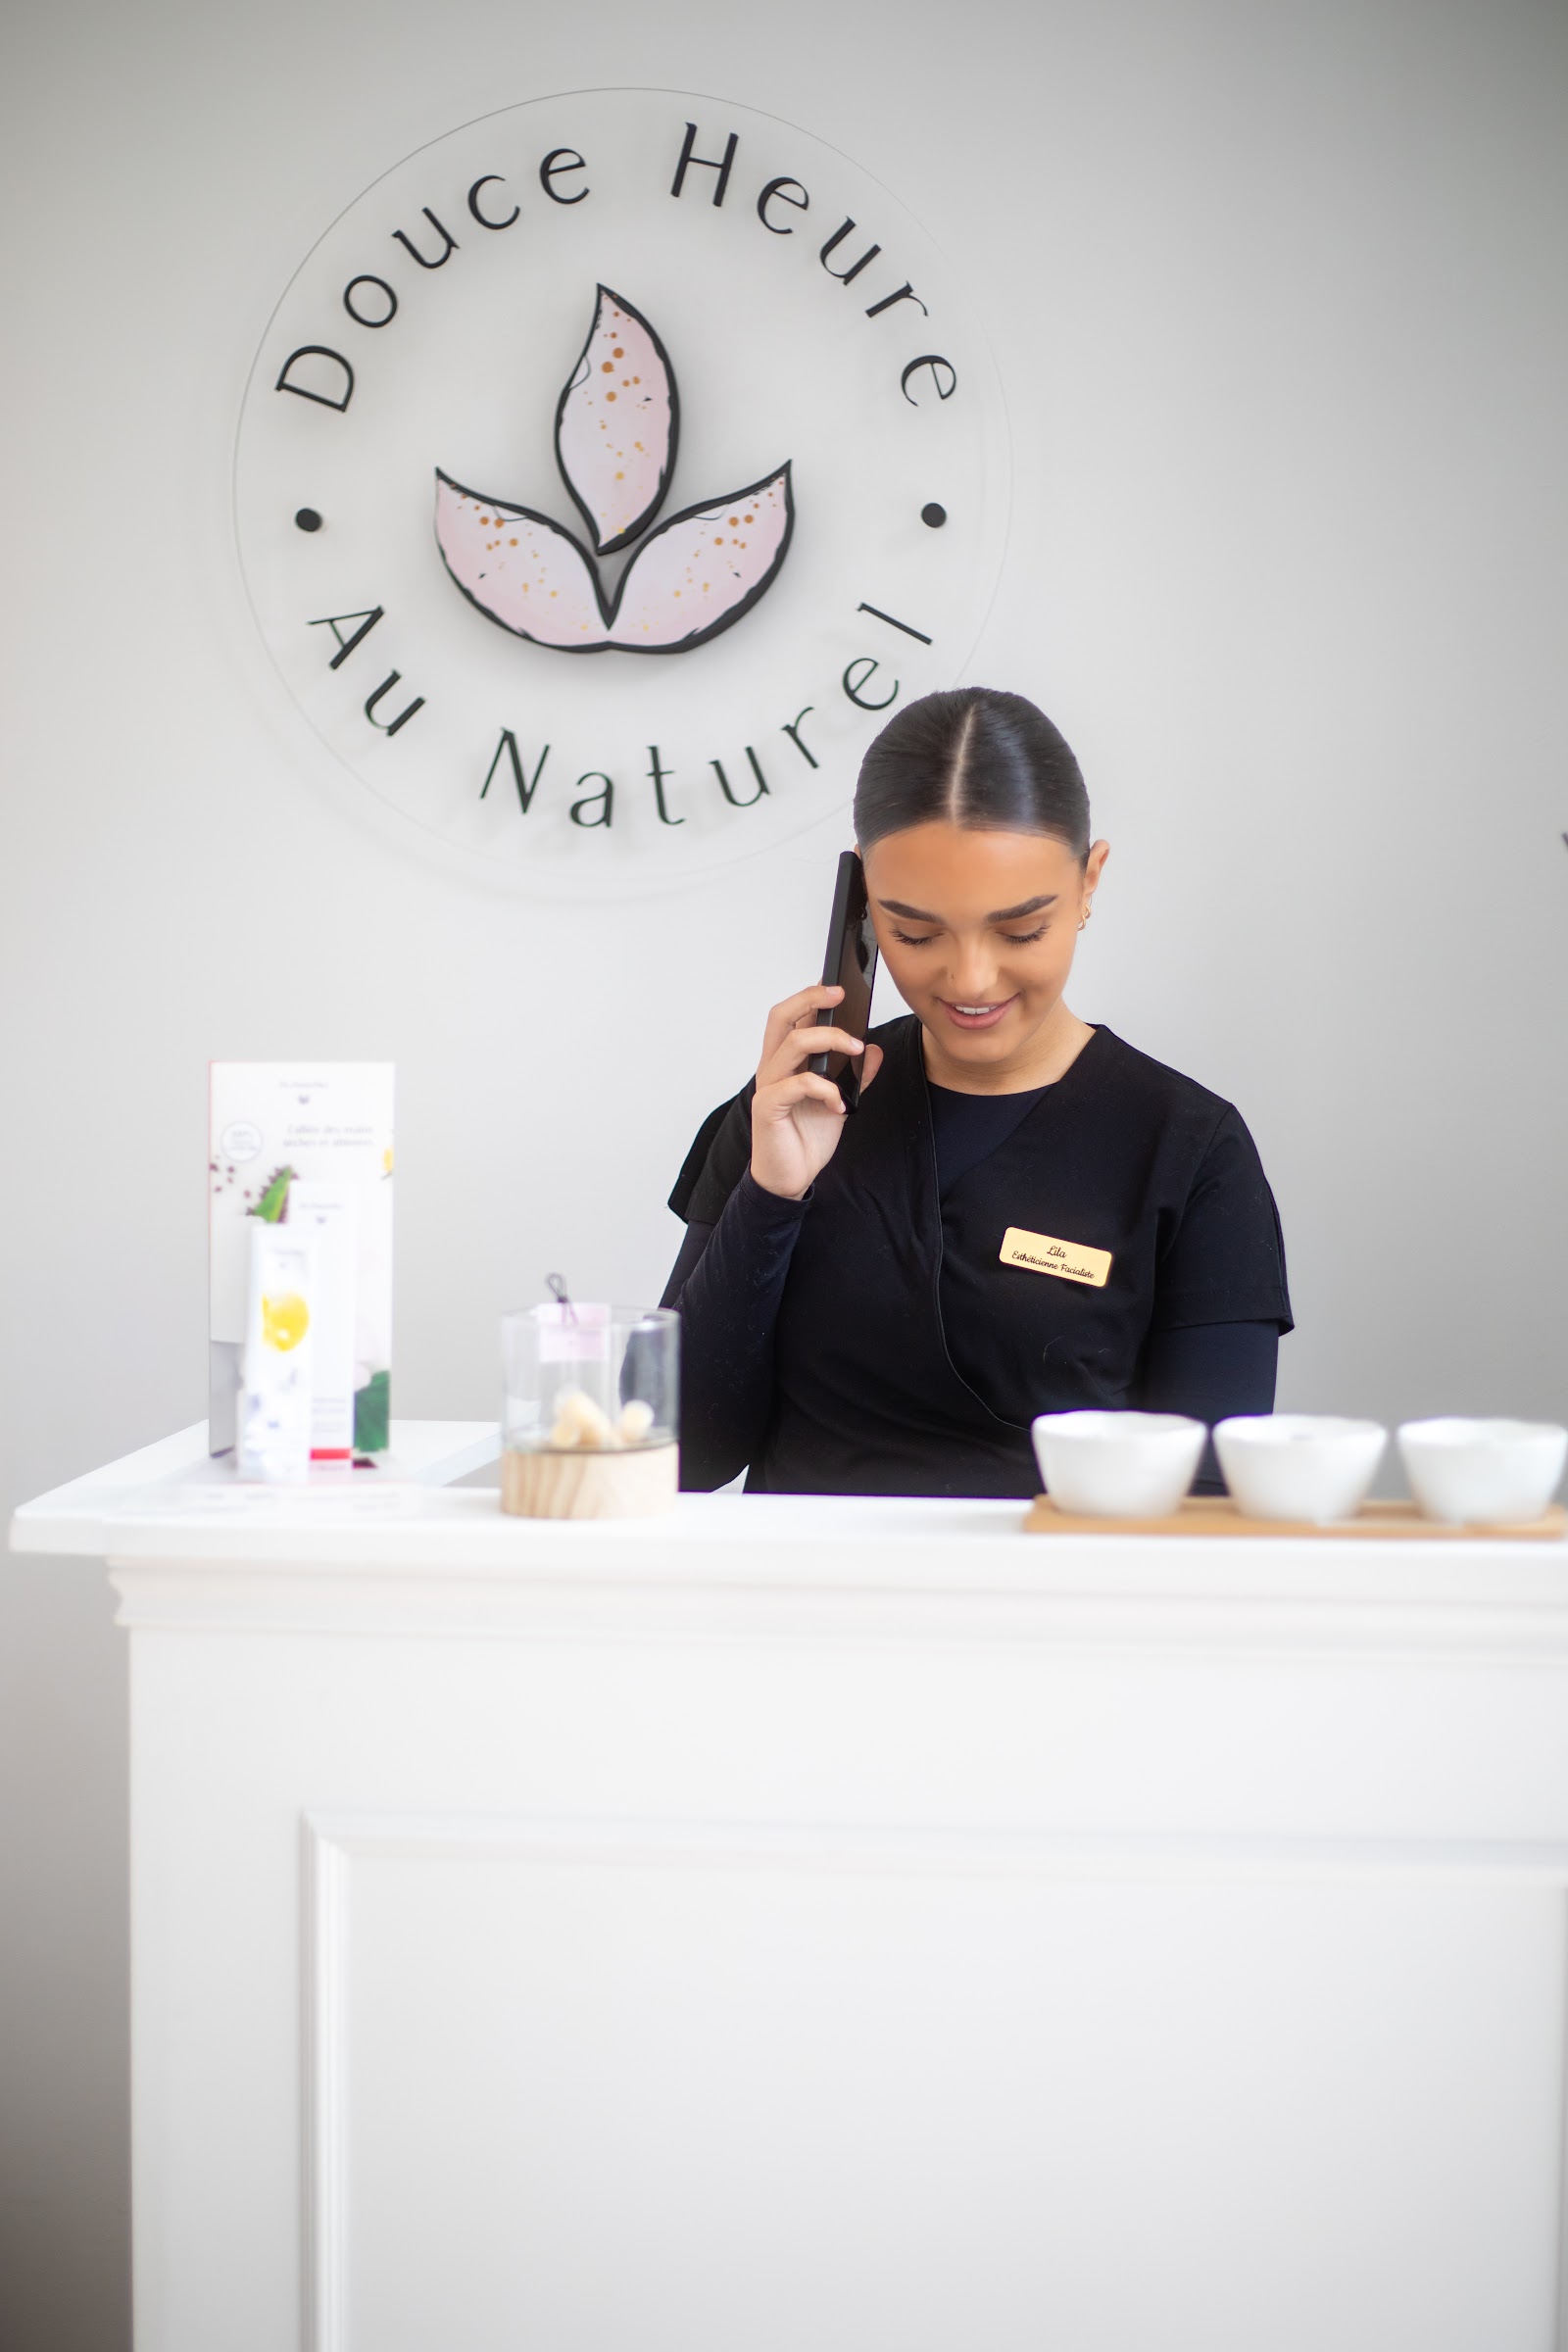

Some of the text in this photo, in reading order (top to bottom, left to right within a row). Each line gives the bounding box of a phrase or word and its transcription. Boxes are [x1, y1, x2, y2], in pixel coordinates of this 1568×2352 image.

[274, 122, 956, 414] Douce Heure
[306, 602, 933, 828] Au Naturel
[1047, 1246, 1067, 1259] Lila
[1060, 1263, 1095, 1279] Facialiste
